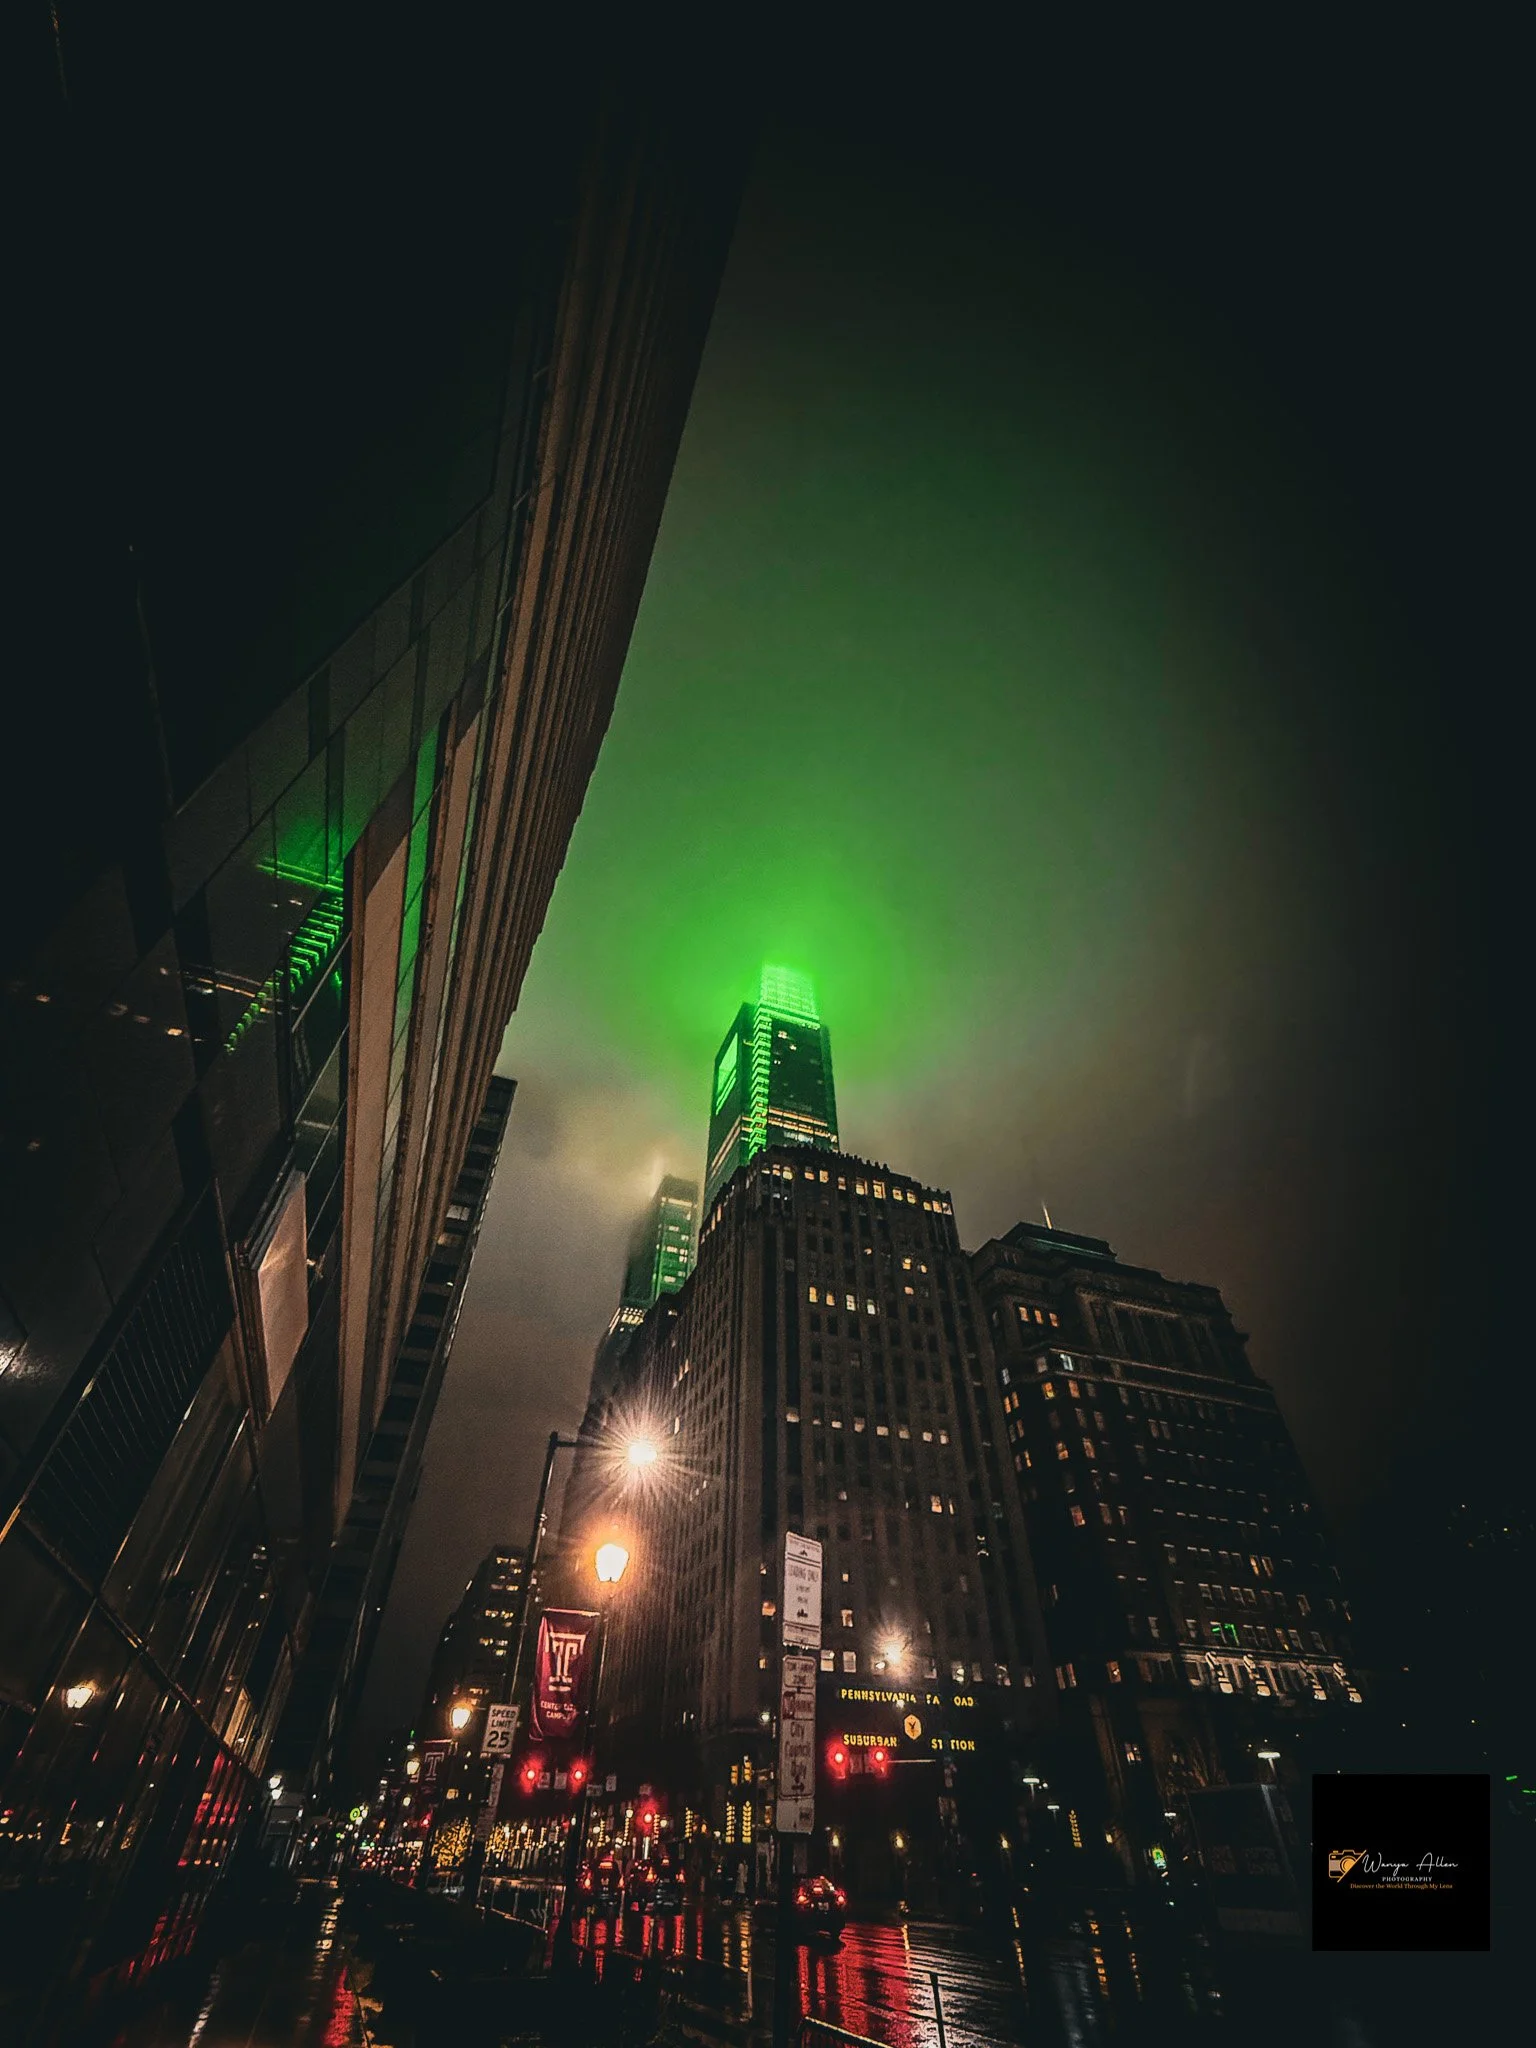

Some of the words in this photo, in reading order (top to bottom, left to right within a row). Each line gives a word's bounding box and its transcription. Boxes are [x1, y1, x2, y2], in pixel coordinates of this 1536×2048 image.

[841, 1688, 917, 1704] PENNSYLVANIA
[540, 1700, 562, 1711] CENTE
[491, 1709, 517, 1718] SPEED
[491, 1719, 512, 1728] LIMIT
[487, 1731, 510, 1748] 25
[843, 1734, 898, 1747] SUBURBAN
[931, 1738, 976, 1751] STTION
